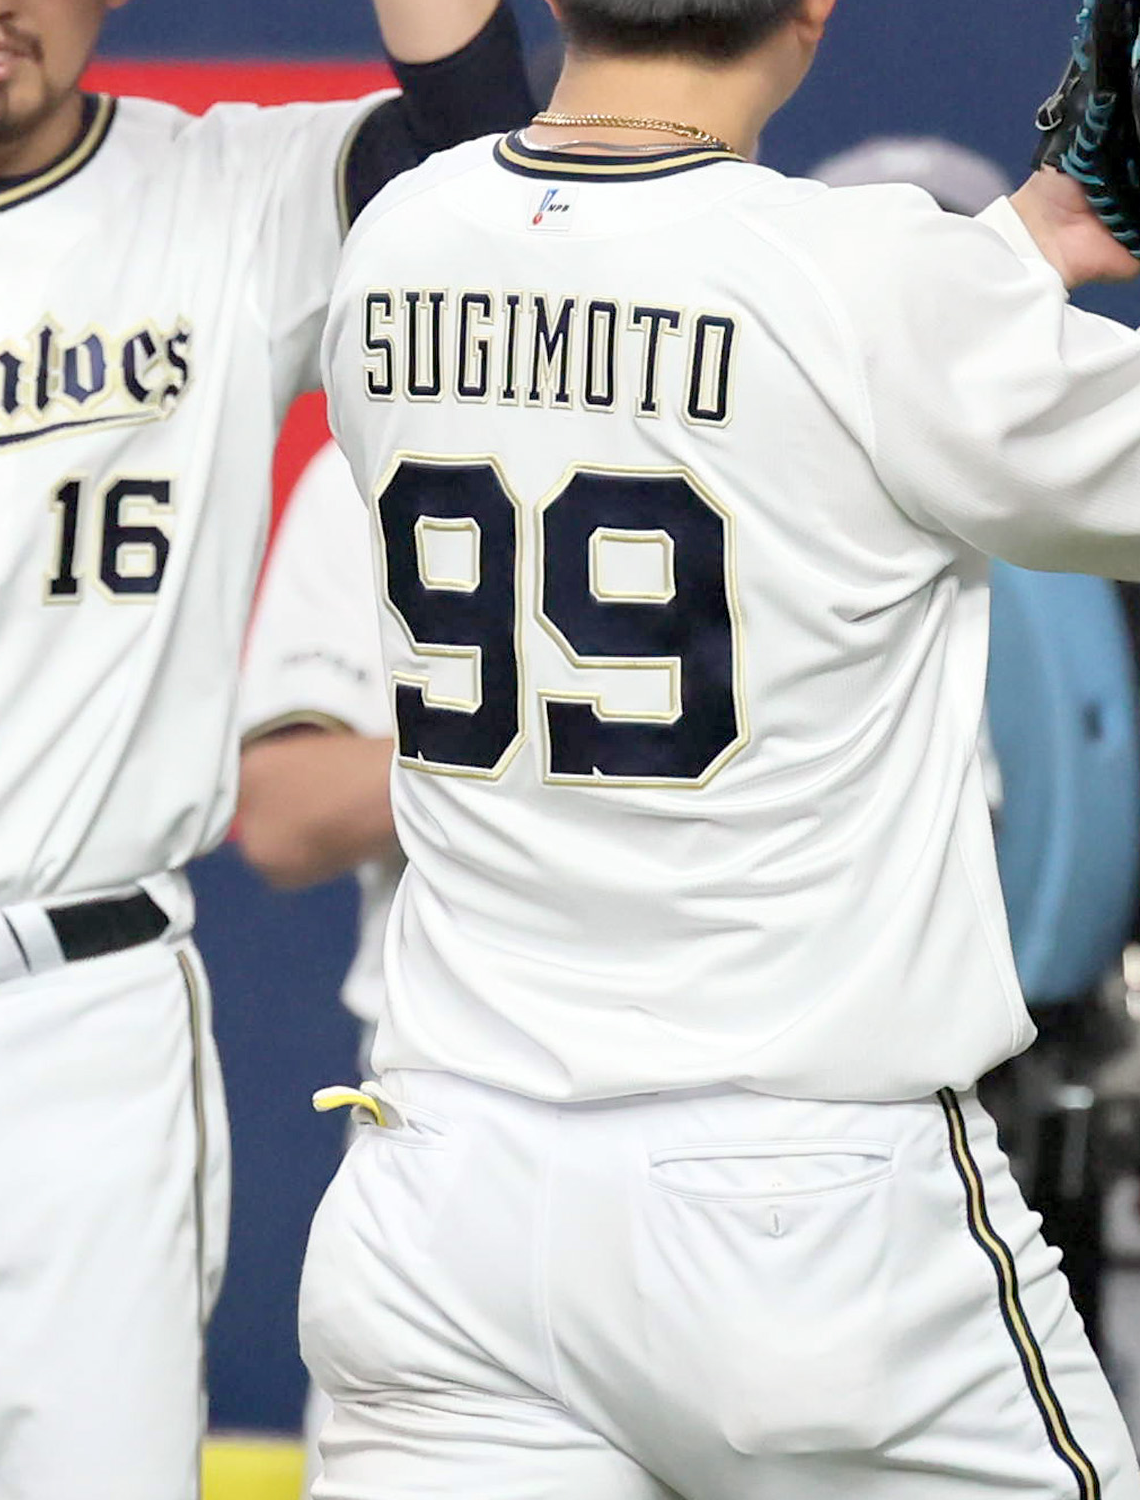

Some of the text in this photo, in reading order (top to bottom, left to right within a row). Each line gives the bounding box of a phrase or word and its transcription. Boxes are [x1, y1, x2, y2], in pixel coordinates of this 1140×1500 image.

[546, 203, 570, 213] NPB
[362, 286, 741, 429] SUGIMOTO
[42, 470, 178, 605] 16
[372, 450, 750, 788] 99
